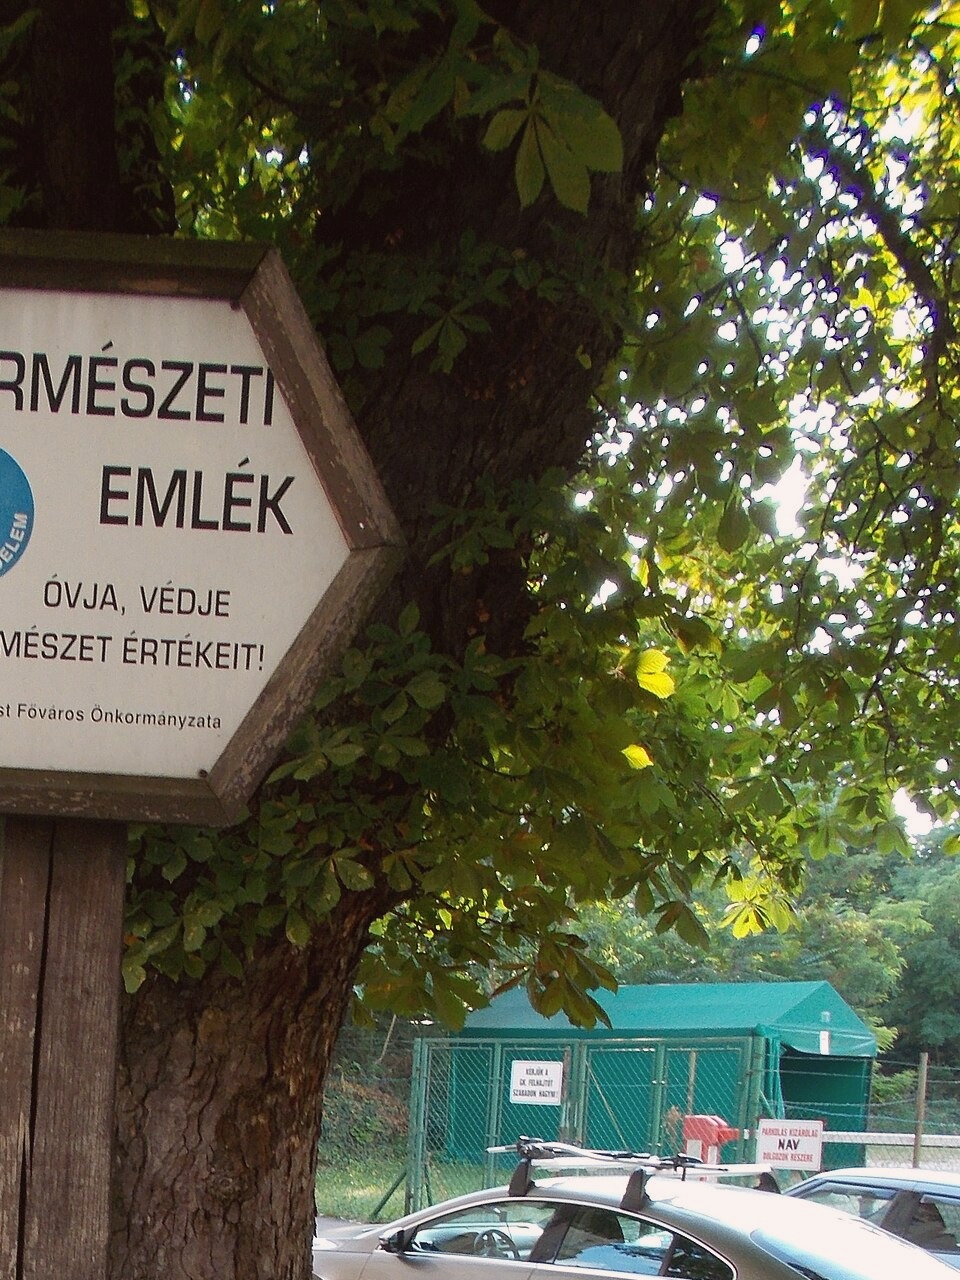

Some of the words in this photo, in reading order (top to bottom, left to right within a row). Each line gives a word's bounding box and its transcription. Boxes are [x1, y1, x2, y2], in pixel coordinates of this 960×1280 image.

[100, 457, 295, 535] EMLÉK
[43, 574, 126, 616] ÓVJA,
[140, 580, 231, 618] VÉDJE
[122, 630, 265, 671] ÉRTÉKEIT!
[90, 704, 222, 730] Önkormányzata
[778, 1138, 800, 1150] NAV
